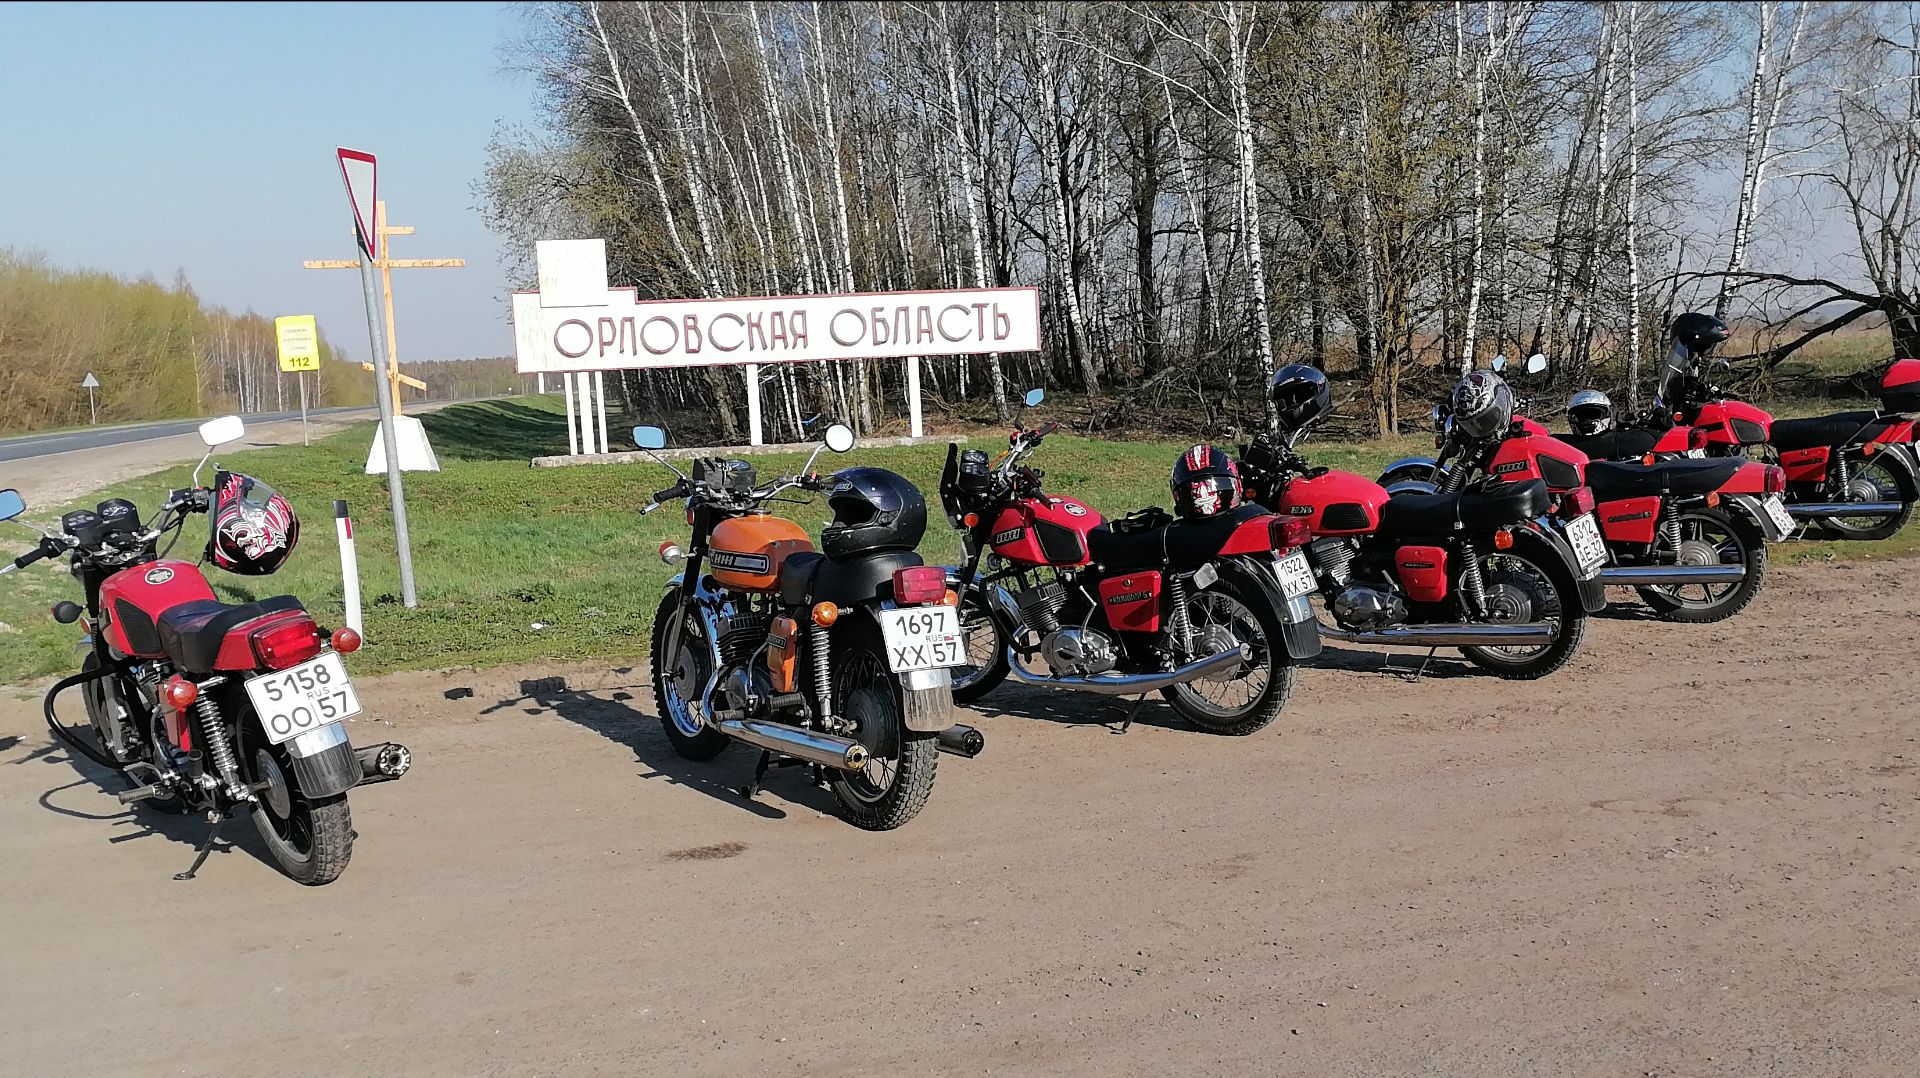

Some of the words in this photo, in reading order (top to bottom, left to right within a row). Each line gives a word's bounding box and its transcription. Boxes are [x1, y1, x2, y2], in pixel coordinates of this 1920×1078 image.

[553, 309, 808, 358] ОРЛОВСКАЯ
[829, 302, 1011, 348] ОБЛАСТЬ
[289, 357, 310, 367] 112
[1572, 519, 1594, 541] 6312
[1591, 540, 1604, 557] 32
[1280, 557, 1304, 576] 1522
[1300, 574, 1313, 590] 57
[896, 612, 945, 636] 1697
[925, 634, 944, 643] RUS
[932, 641, 957, 663] 57
[263, 663, 331, 702] 5158
[306, 686, 330, 700] RUS
[317, 690, 348, 719] 57
